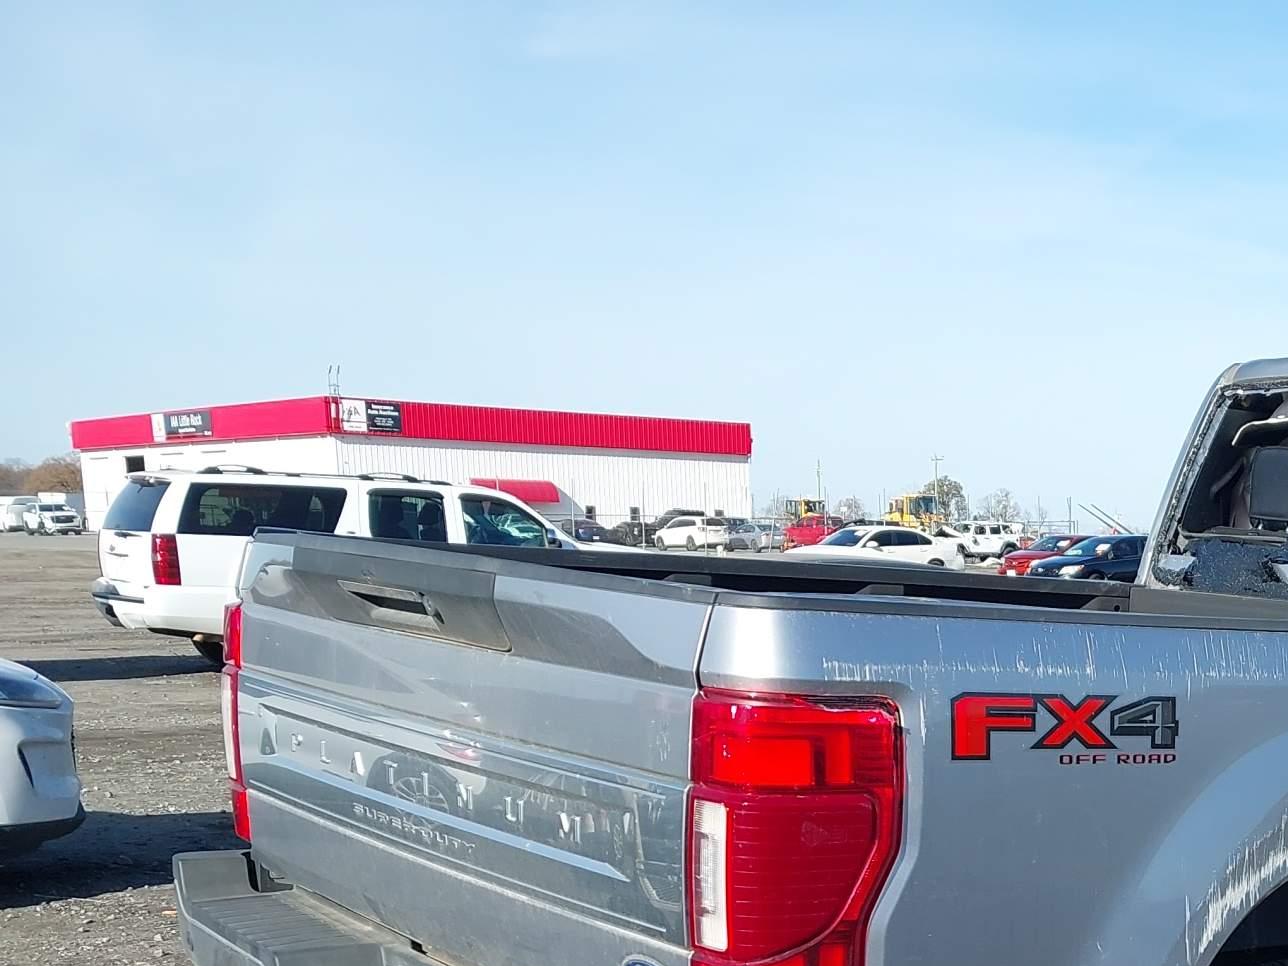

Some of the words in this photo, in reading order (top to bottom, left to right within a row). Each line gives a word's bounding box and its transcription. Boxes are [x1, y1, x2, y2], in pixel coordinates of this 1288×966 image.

[190, 413, 203, 426] Rock
[950, 691, 1179, 760] FX4
[1058, 753, 1107, 765] OFF
[1116, 753, 1176, 765] ROAD
[290, 732, 582, 844] PLATINUM
